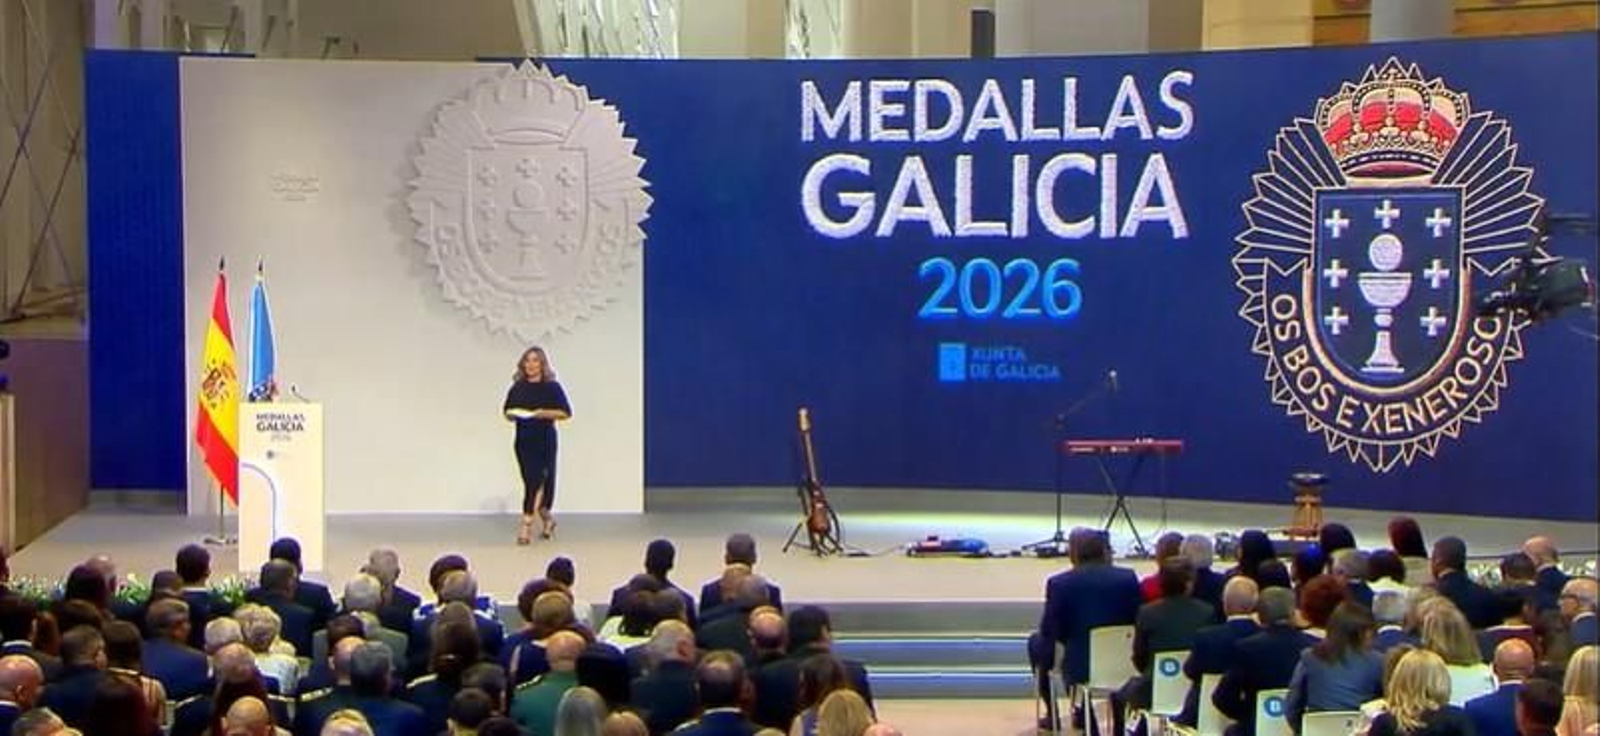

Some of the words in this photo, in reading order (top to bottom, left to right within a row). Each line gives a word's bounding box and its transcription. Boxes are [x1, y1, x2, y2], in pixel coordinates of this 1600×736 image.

[801, 71, 1194, 142] MEDALLAS
[801, 152, 1190, 239] GALICIA
[918, 257, 1083, 319] 2026
[1271, 293, 1301, 342] OS
[970, 364, 991, 380] DE
[995, 363, 1062, 380] GALICIA
[971, 346, 1027, 361] XUNTA
[1283, 345, 1337, 412] BOS
[256, 422, 304, 432] GALICIA
